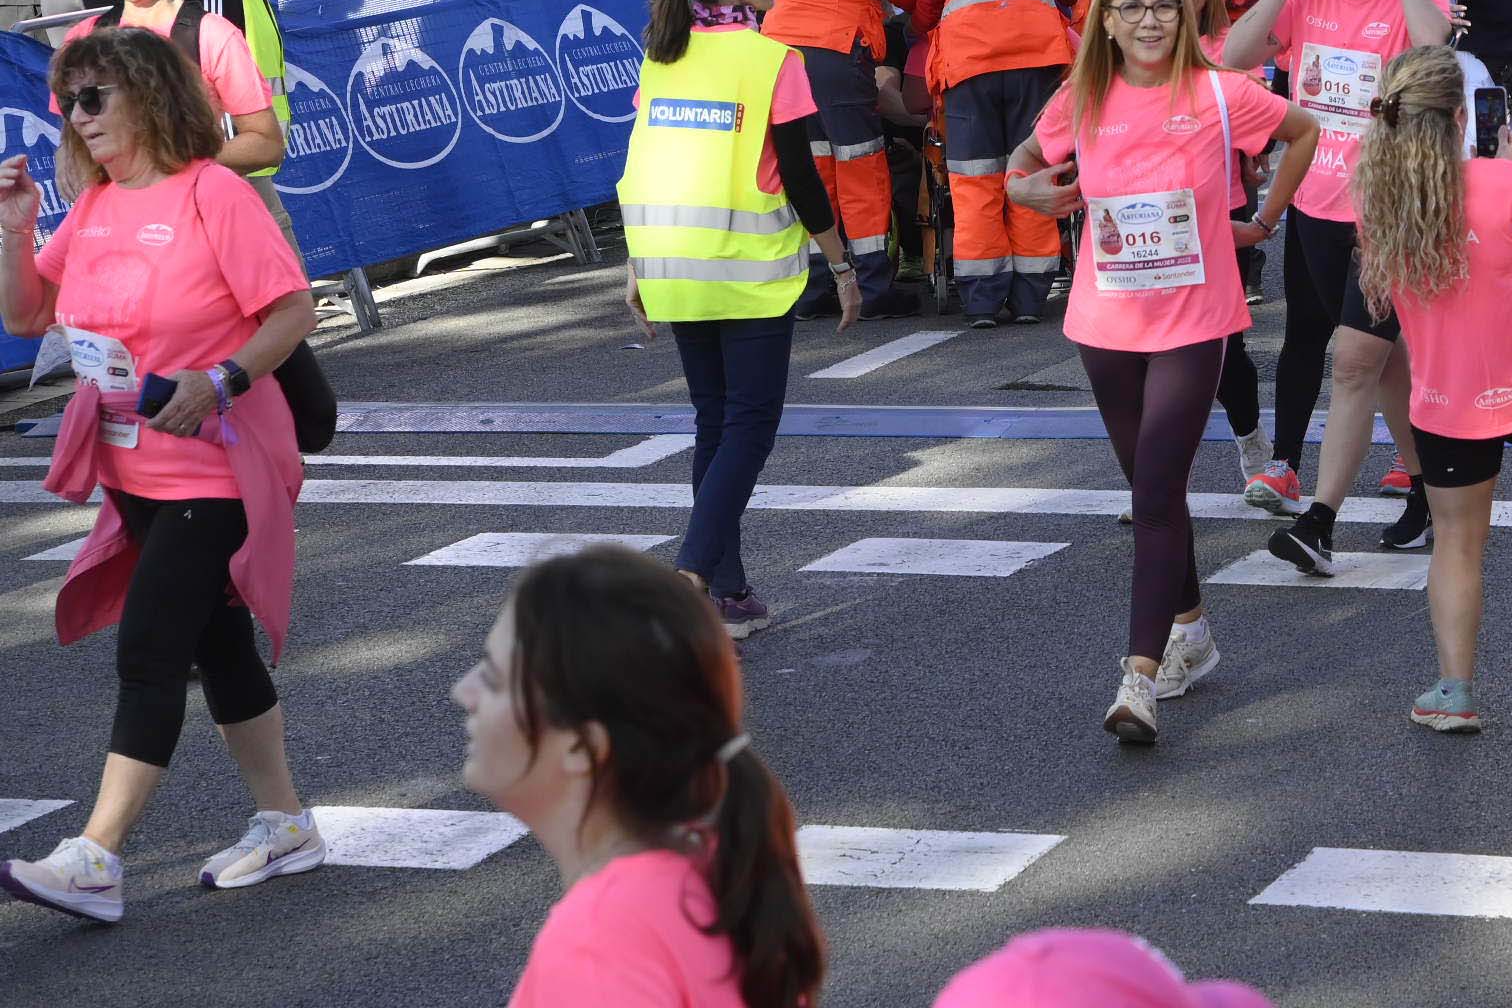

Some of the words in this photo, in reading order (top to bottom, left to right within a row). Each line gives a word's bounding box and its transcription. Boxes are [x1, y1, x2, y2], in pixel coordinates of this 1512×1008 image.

[469, 68, 561, 117] ASTURIANA
[1324, 80, 1351, 95] 016
[1328, 95, 1346, 105] 9475
[357, 92, 457, 143] ASTURIANA
[651, 105, 732, 124] VOLUNTARIS
[1312, 147, 1347, 170] UMA
[1120, 211, 1161, 221] ASTURIANA
[1125, 231, 1162, 247] 016
[1131, 249, 1159, 259] 16244
[1153, 259, 1176, 267] MUJER
